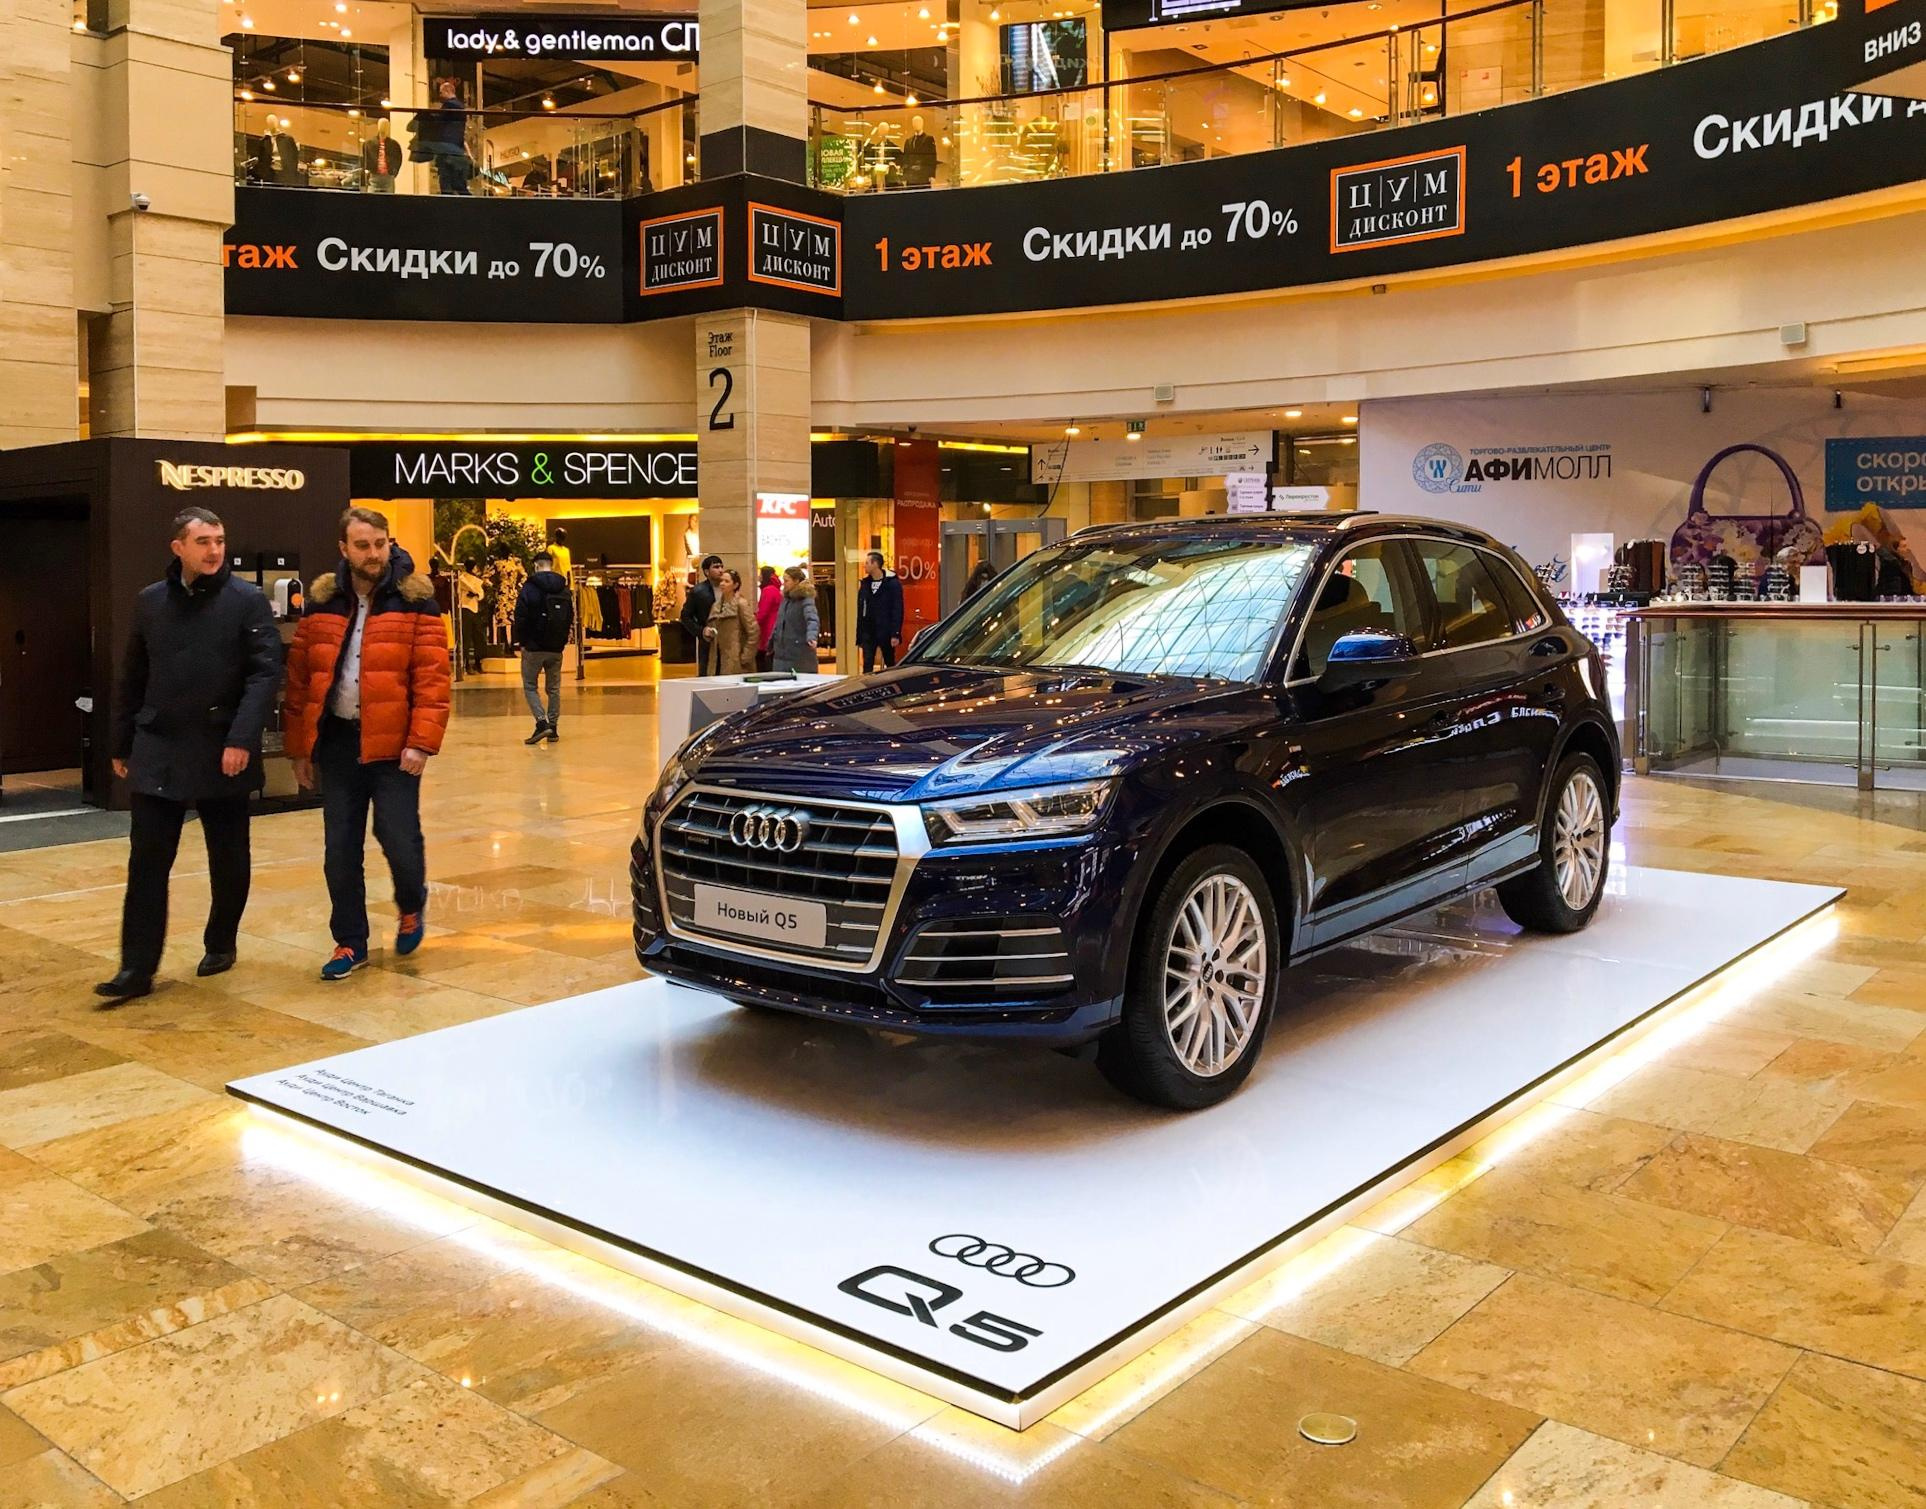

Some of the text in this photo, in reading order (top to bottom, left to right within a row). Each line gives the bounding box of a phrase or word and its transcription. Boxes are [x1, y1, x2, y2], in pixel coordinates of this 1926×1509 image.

[447, 28, 499, 53] lady
[503, 29, 520, 50] &
[525, 31, 654, 54] gentleman
[1693, 93, 1892, 160] Скидки
[1506, 144, 1649, 198] 1 этаж
[1349, 204, 1448, 239] ДИСКОНТ
[875, 200, 1298, 272] 1 этаж Скидки до 70%
[316, 237, 478, 279] Скидки
[488, 260, 520, 279] до
[529, 241, 606, 278] 70%
[651, 257, 713, 283] ДИСКОНТ
[762, 254, 831, 281] ДИСКОНТ
[708, 331, 734, 344] Этаж
[709, 345, 733, 358] Floor
[709, 367, 734, 430] 2
[154, 459, 305, 491] NESPRESSO
[395, 451, 698, 485] MARKS & SPENCE
[1464, 455, 1611, 482] АФИМОЛЛ
[1446, 478, 1483, 493] Сити
[760, 498, 798, 515] KFC
[898, 555, 937, 581] 50%
[717, 902, 797, 930] Новый Q5
[837, 1265, 1044, 1353] Q5
